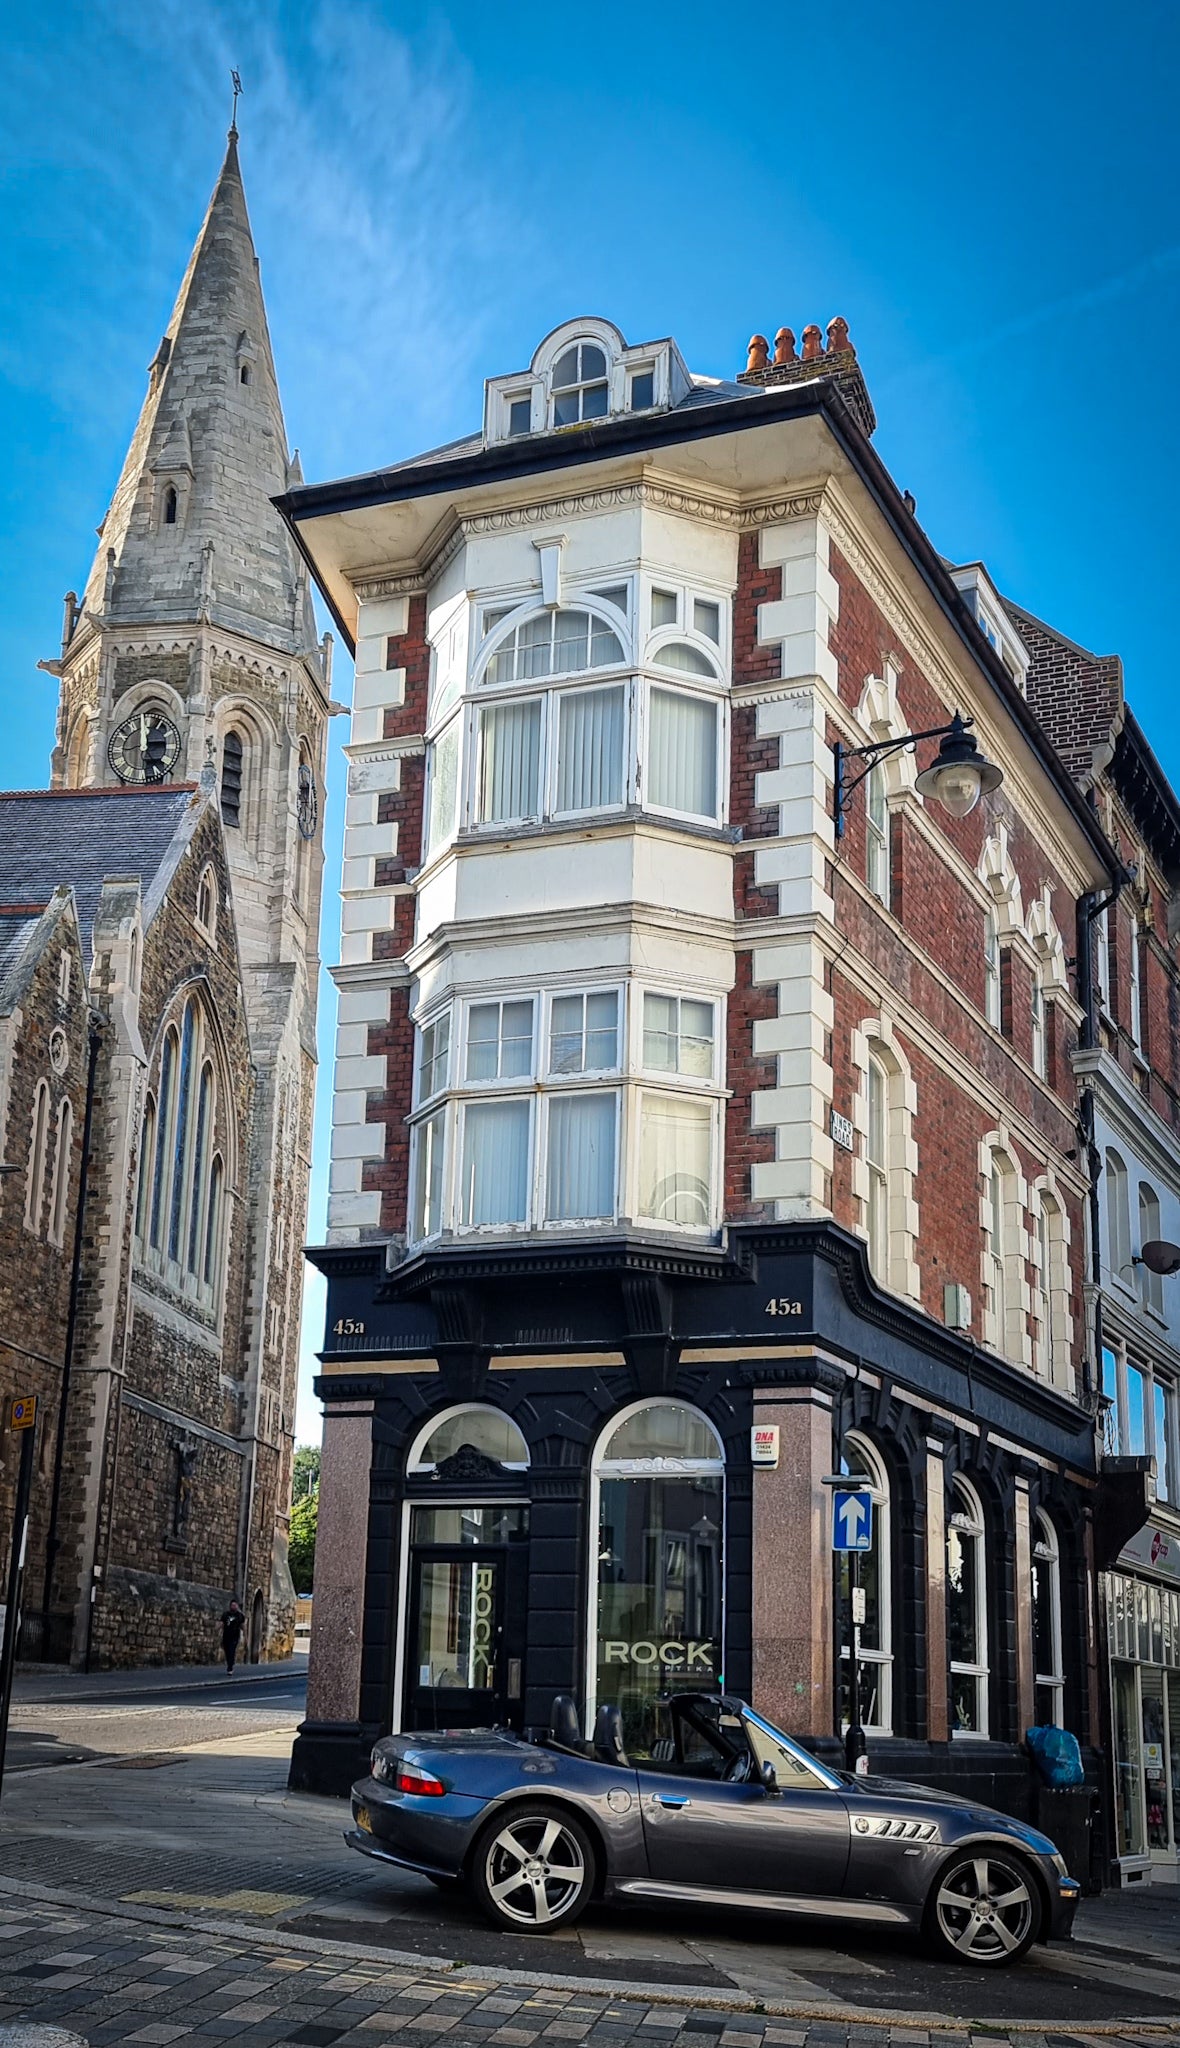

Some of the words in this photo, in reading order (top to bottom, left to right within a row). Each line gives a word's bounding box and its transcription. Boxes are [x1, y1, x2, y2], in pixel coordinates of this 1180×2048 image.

[832, 1112, 851, 1135] KINGS
[833, 1126, 850, 1146] ROAD
[765, 1298, 802, 1316] 45a
[333, 1318, 365, 1335] 45a
[755, 1432, 774, 1441] DNA
[474, 1569, 493, 1667] ROCK
[605, 1641, 713, 1665] ROCK
